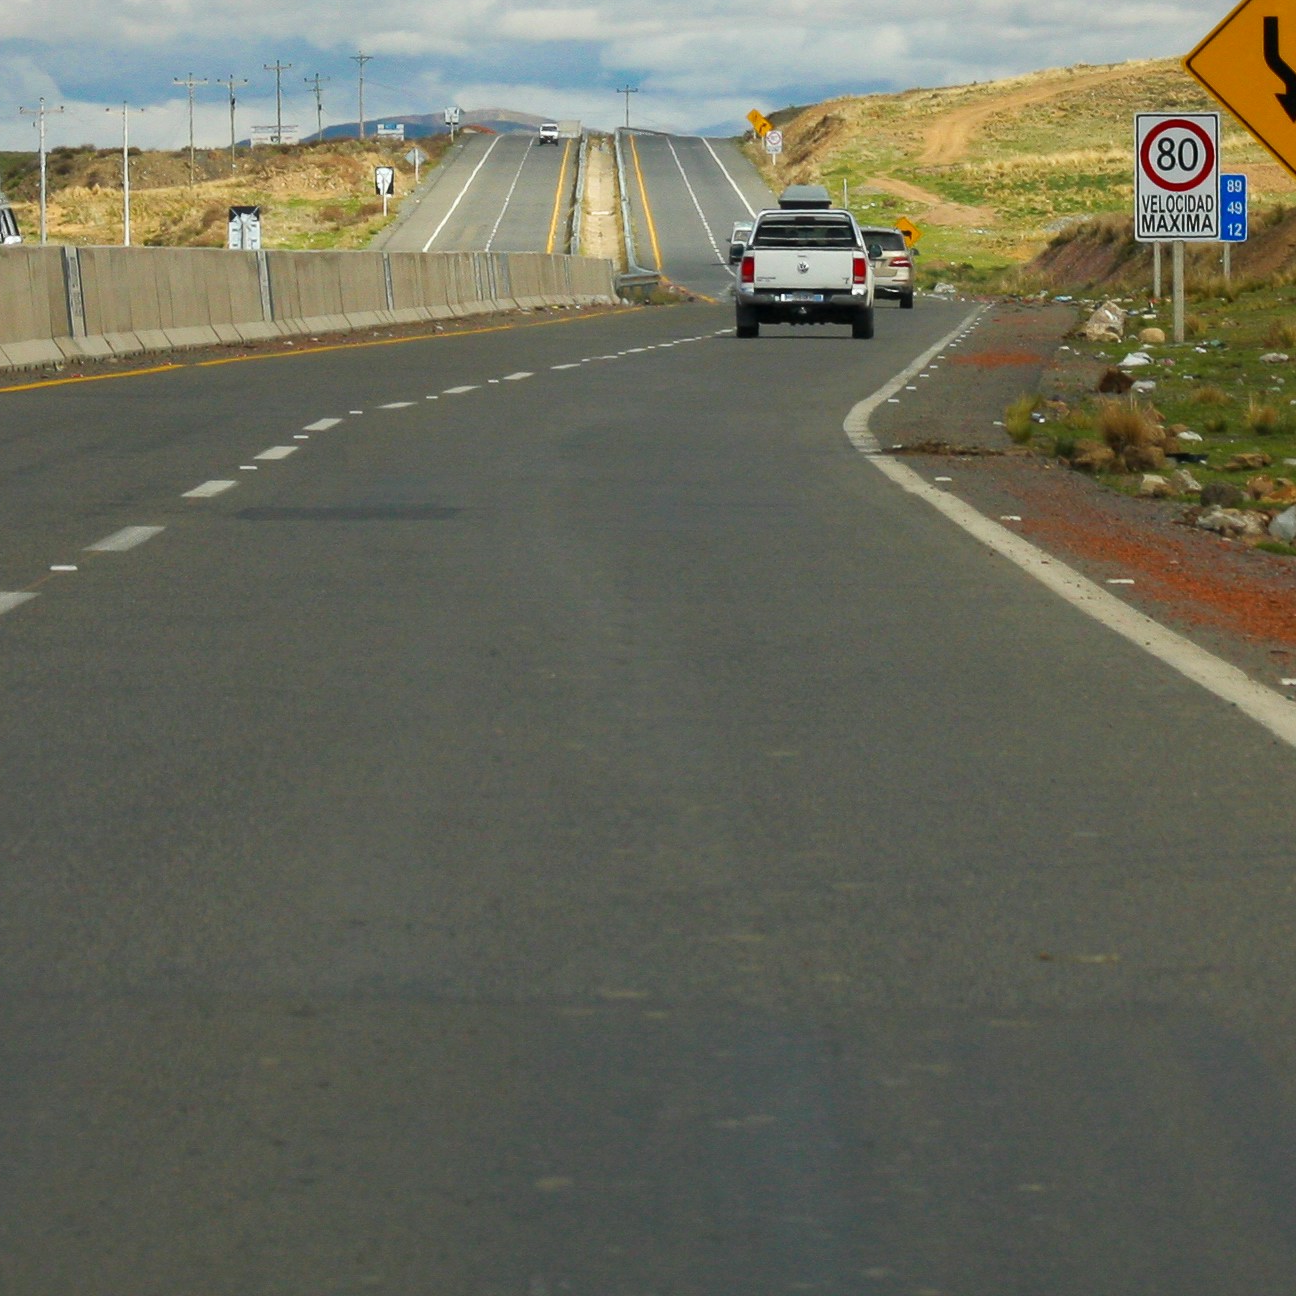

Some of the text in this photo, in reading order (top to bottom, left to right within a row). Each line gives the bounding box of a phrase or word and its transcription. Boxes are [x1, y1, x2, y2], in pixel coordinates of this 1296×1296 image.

[1157, 138, 1198, 171] 80
[1227, 180, 1242, 193] 89
[1142, 194, 1214, 213] VELOCIDAD
[1227, 202, 1243, 215] 49
[1142, 214, 1213, 233] MAXIMA
[1227, 224, 1242, 237] 12
